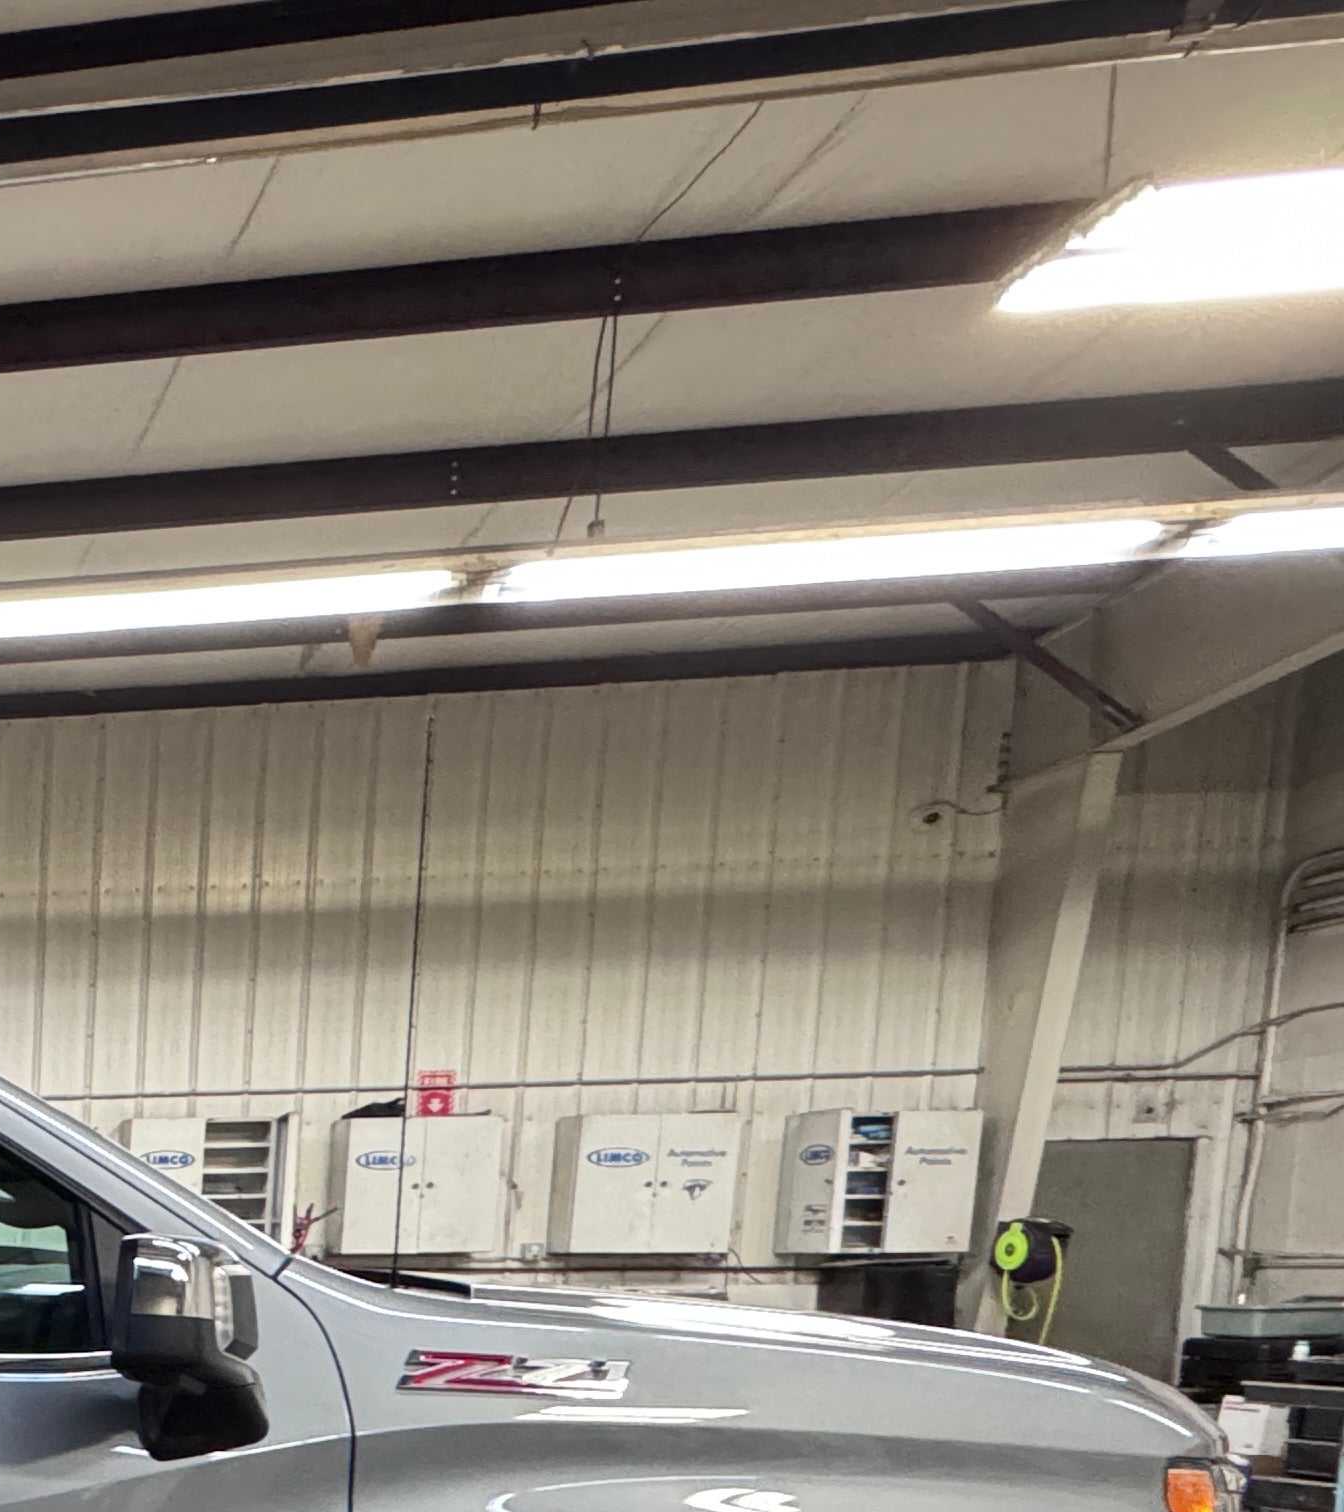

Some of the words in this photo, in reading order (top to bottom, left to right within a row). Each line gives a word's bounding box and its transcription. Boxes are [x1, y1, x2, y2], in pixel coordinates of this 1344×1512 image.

[146, 1155, 189, 1165] LIMCO
[596, 1152, 643, 1164] LIMCO
[397, 1349, 630, 1400] Z71
